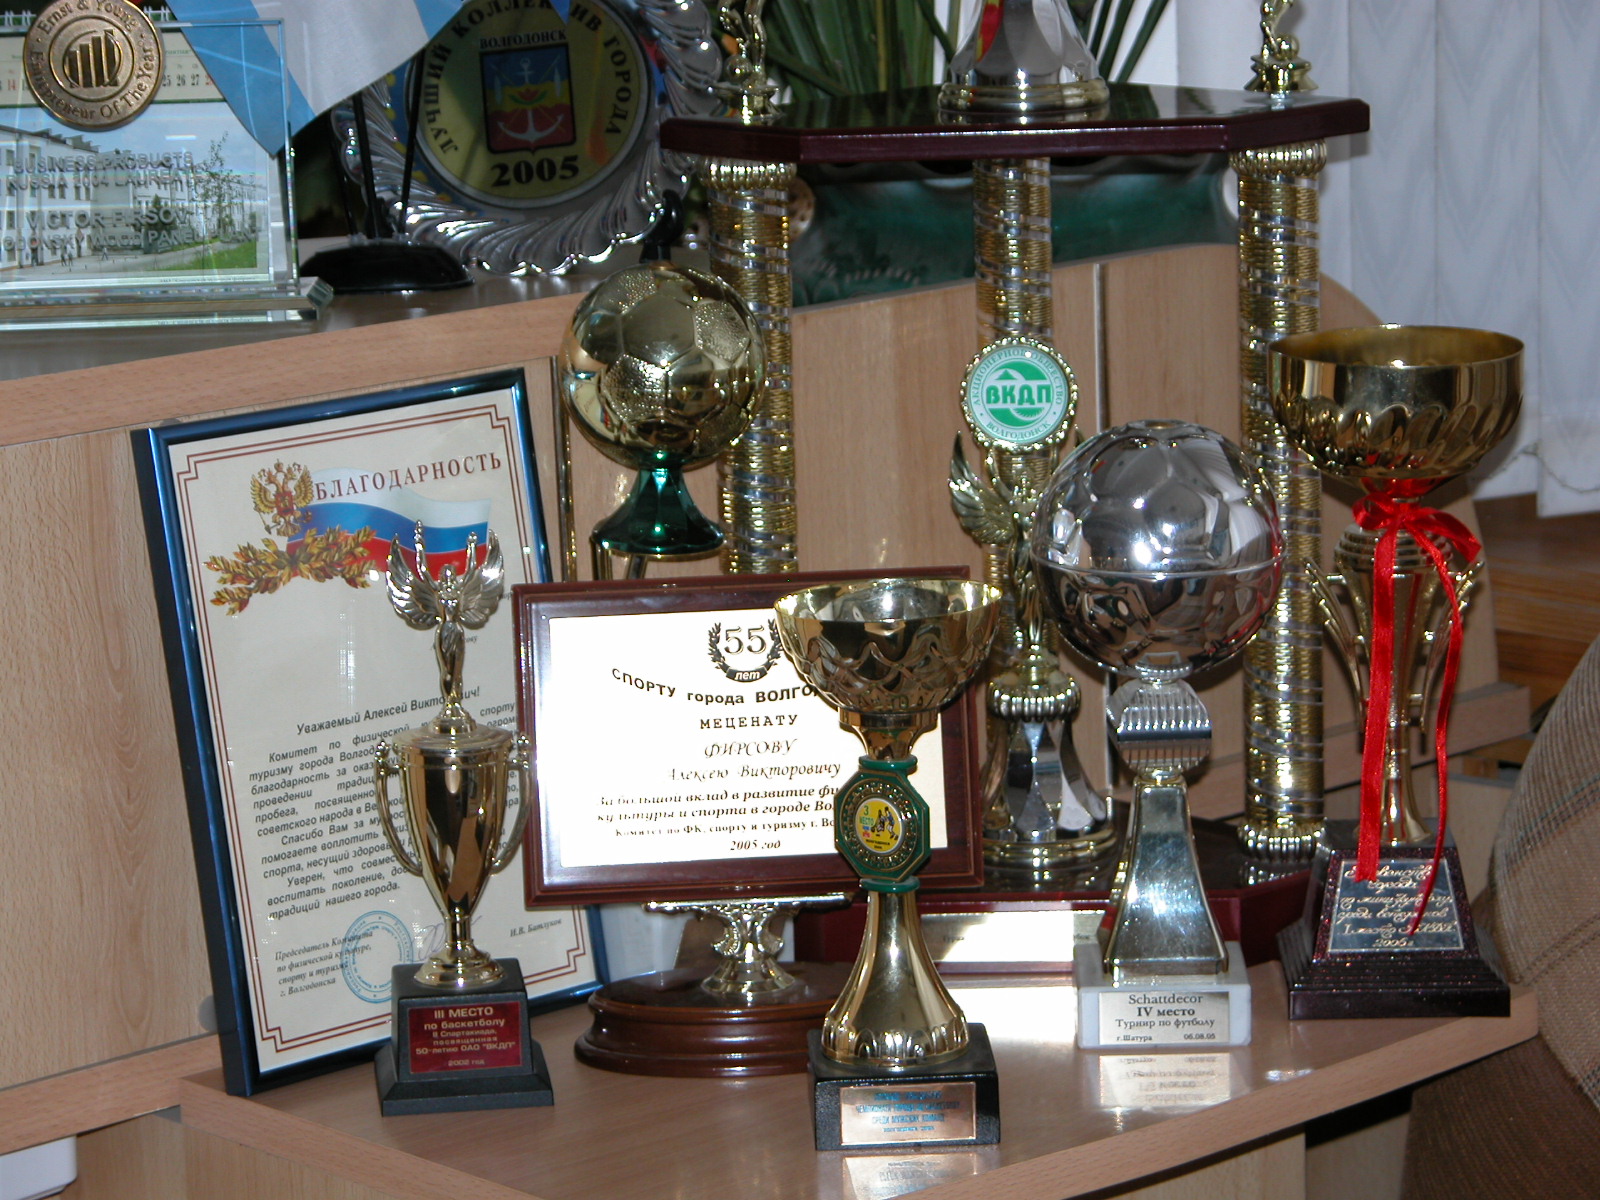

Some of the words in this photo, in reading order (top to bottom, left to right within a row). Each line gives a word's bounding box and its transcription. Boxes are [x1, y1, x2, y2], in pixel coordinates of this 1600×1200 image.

[36, 2, 73, 35] Ernst
[77, 0, 90, 11] &
[96, 0, 140, 33] Young
[451, 0, 603, 39] КОЛЛЕКИВ
[479, 29, 568, 50] ВОЛГОДОНСК
[100, 103, 123, 119] Of
[119, 82, 148, 109] The
[136, 46, 156, 81] Year
[602, 35, 633, 137] ГОРОДА
[423, 42, 459, 154] ЛУЧШИЙ
[490, 154, 580, 188] 2005
[6, 172, 69, 193] RUSSIA
[25, 209, 106, 230] VICTOR
[985, 384, 1052, 406] ВКДП
[985, 421, 1052, 441] ВОЛГОДОНСК
[315, 451, 502, 501] БЛАГОДАРНОСТЬ
[723, 624, 768, 655] 55
[611, 667, 677, 698] СПОРТУ
[687, 691, 745, 706] города
[734, 670, 761, 682] лет
[296, 711, 361, 736] Уважаемый
[363, 700, 408, 722] Алексей
[700, 714, 799, 730] МЕЦЕНАТУ
[268, 744, 318, 763] Комитет
[328, 739, 342, 752] по
[479, 701, 516, 718] спорту
[704, 738, 799, 759] ФИРСОВУ
[249, 764, 294, 783] туризму
[299, 755, 334, 772] города
[738, 763, 842, 781] Викторовичу
[250, 771, 331, 796] благодарность
[336, 766, 347, 778] за
[253, 788, 313, 811] проведении
[686, 790, 729, 803] вклад
[731, 792, 740, 800] в
[743, 788, 815, 802] развитие
[255, 807, 299, 824] пробега,
[314, 790, 376, 811] посвященно
[679, 810, 687, 818] и
[691, 805, 747, 819] спорта
[762, 801, 811, 815] городе
[863, 805, 869, 816] 3
[257, 817, 317, 838] советского
[319, 807, 354, 825] народа
[356, 806, 362, 815] в
[709, 823, 747, 834] спорту
[762, 821, 807, 832] туризму
[281, 829, 324, 846] Спасибо
[328, 823, 349, 836] Вам
[353, 820, 364, 830] за
[261, 843, 318, 865] помогаете
[321, 832, 380, 851] воплотить
[730, 839, 758, 851] 2005
[761, 839, 781, 850] год
[263, 861, 304, 879] спорта,
[306, 851, 351, 870] несущий
[286, 872, 326, 888] Уверен,
[333, 866, 354, 876] что
[267, 886, 326, 906] воспитать
[331, 871, 386, 891] поколение,
[268, 900, 321, 920] традиций
[325, 890, 362, 908] нашего
[364, 881, 400, 898] города.
[275, 942, 330, 961] Председатель
[276, 965, 286, 973] по
[288, 952, 333, 972] физической
[278, 971, 307, 985] спорту
[308, 969, 314, 977] и
[288, 977, 336, 996] Волгодонска
[1128, 993, 1204, 1005] Schattdecor
[434, 1010, 444, 1018] III
[448, 1006, 495, 1019] МЕСТО
[1136, 1006, 1153, 1017] IV
[1156, 1008, 1196, 1017] место
[440, 1018, 506, 1031] баскетболу
[1115, 1018, 1156, 1030] Турнир
[1158, 1019, 1172, 1027] по
[1173, 1017, 1216, 1030] футболу
[416, 1047, 458, 1056] 50-летию
[461, 1043, 480, 1051] ОАО
[433, 1036, 498, 1046] посвященная
